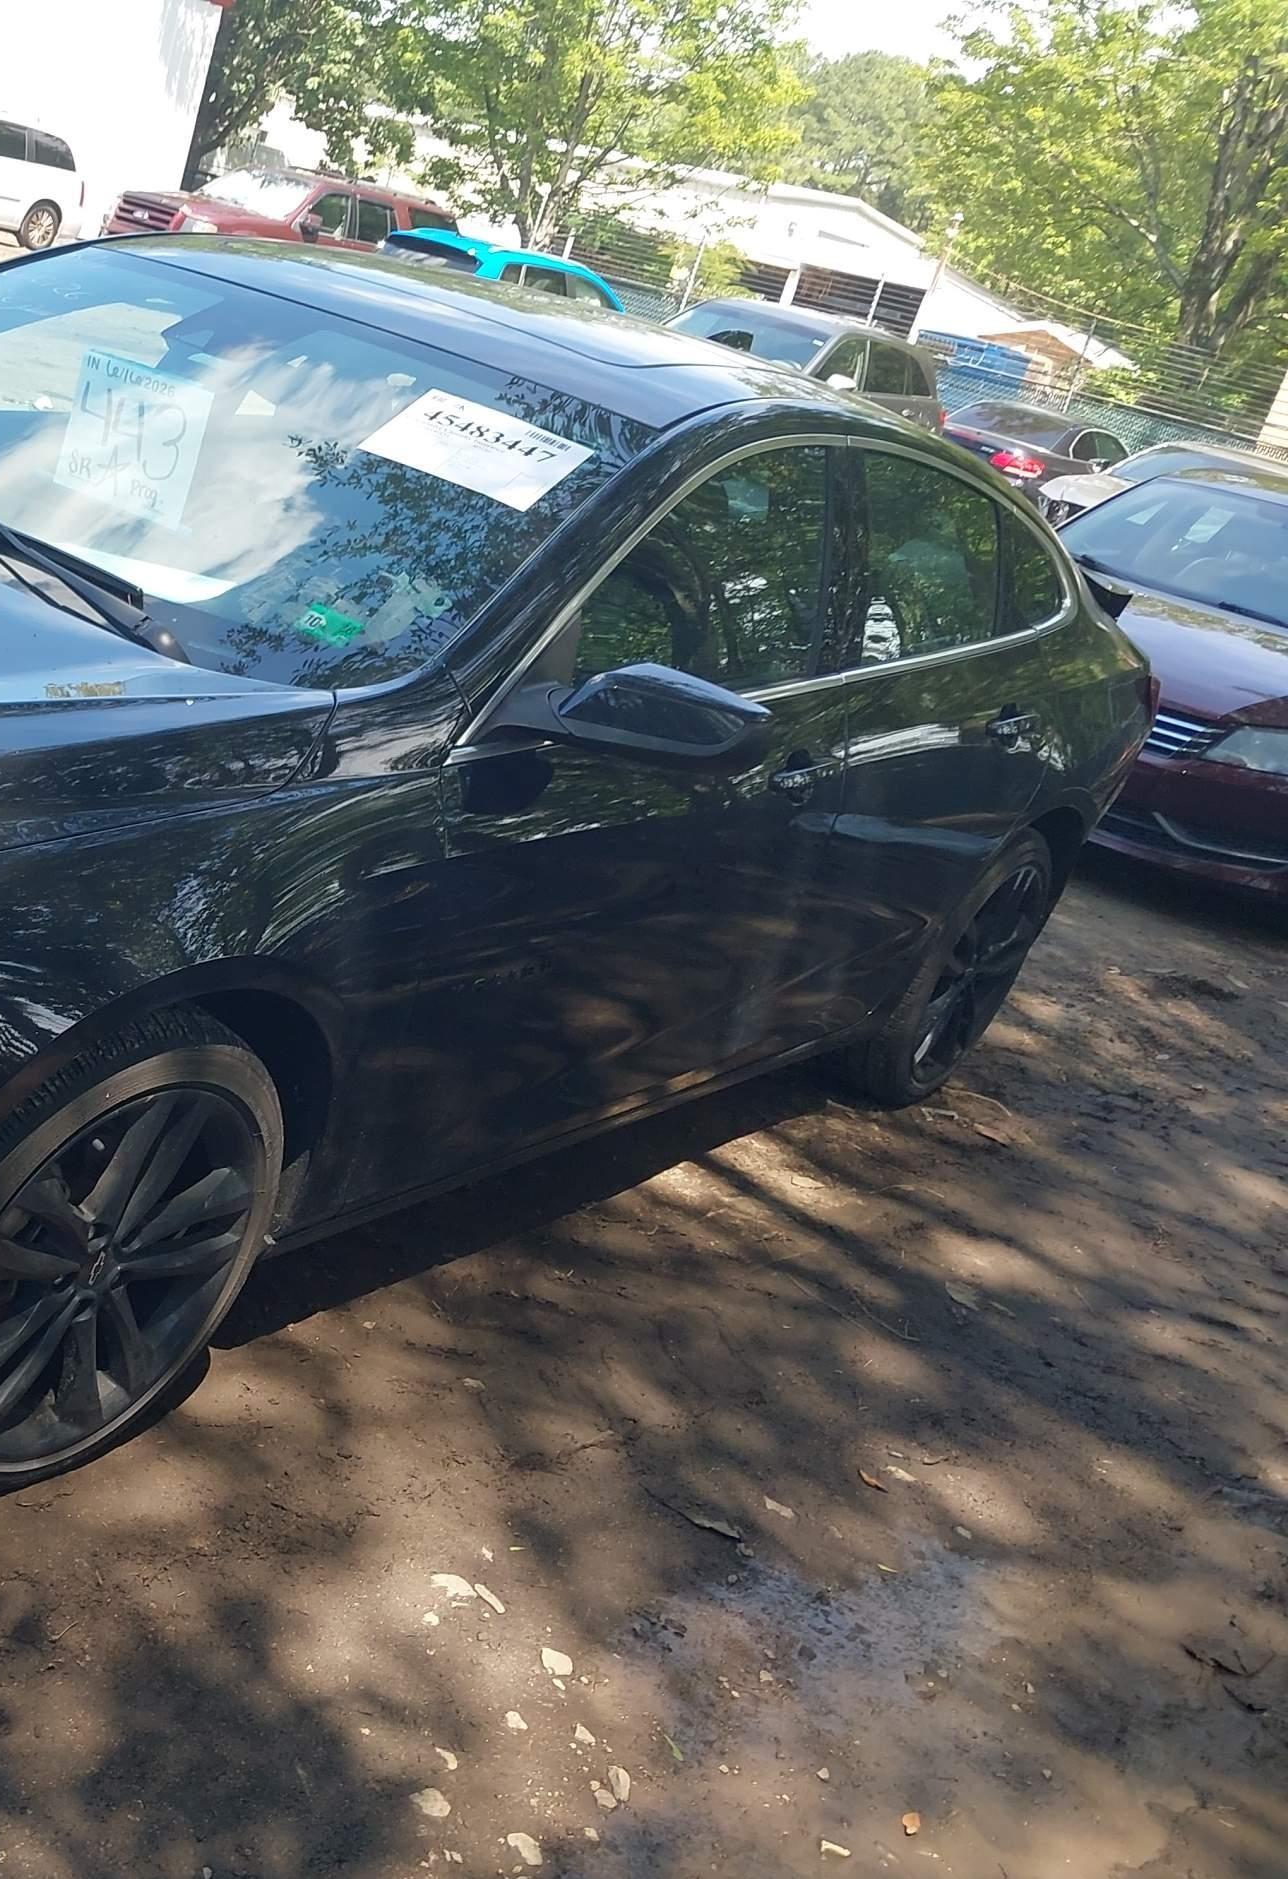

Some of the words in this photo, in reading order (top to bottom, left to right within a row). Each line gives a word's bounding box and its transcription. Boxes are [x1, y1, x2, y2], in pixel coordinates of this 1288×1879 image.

[86, 354, 101, 371] IN
[80, 380, 187, 481] 443
[422, 409, 557, 463] 45483447
